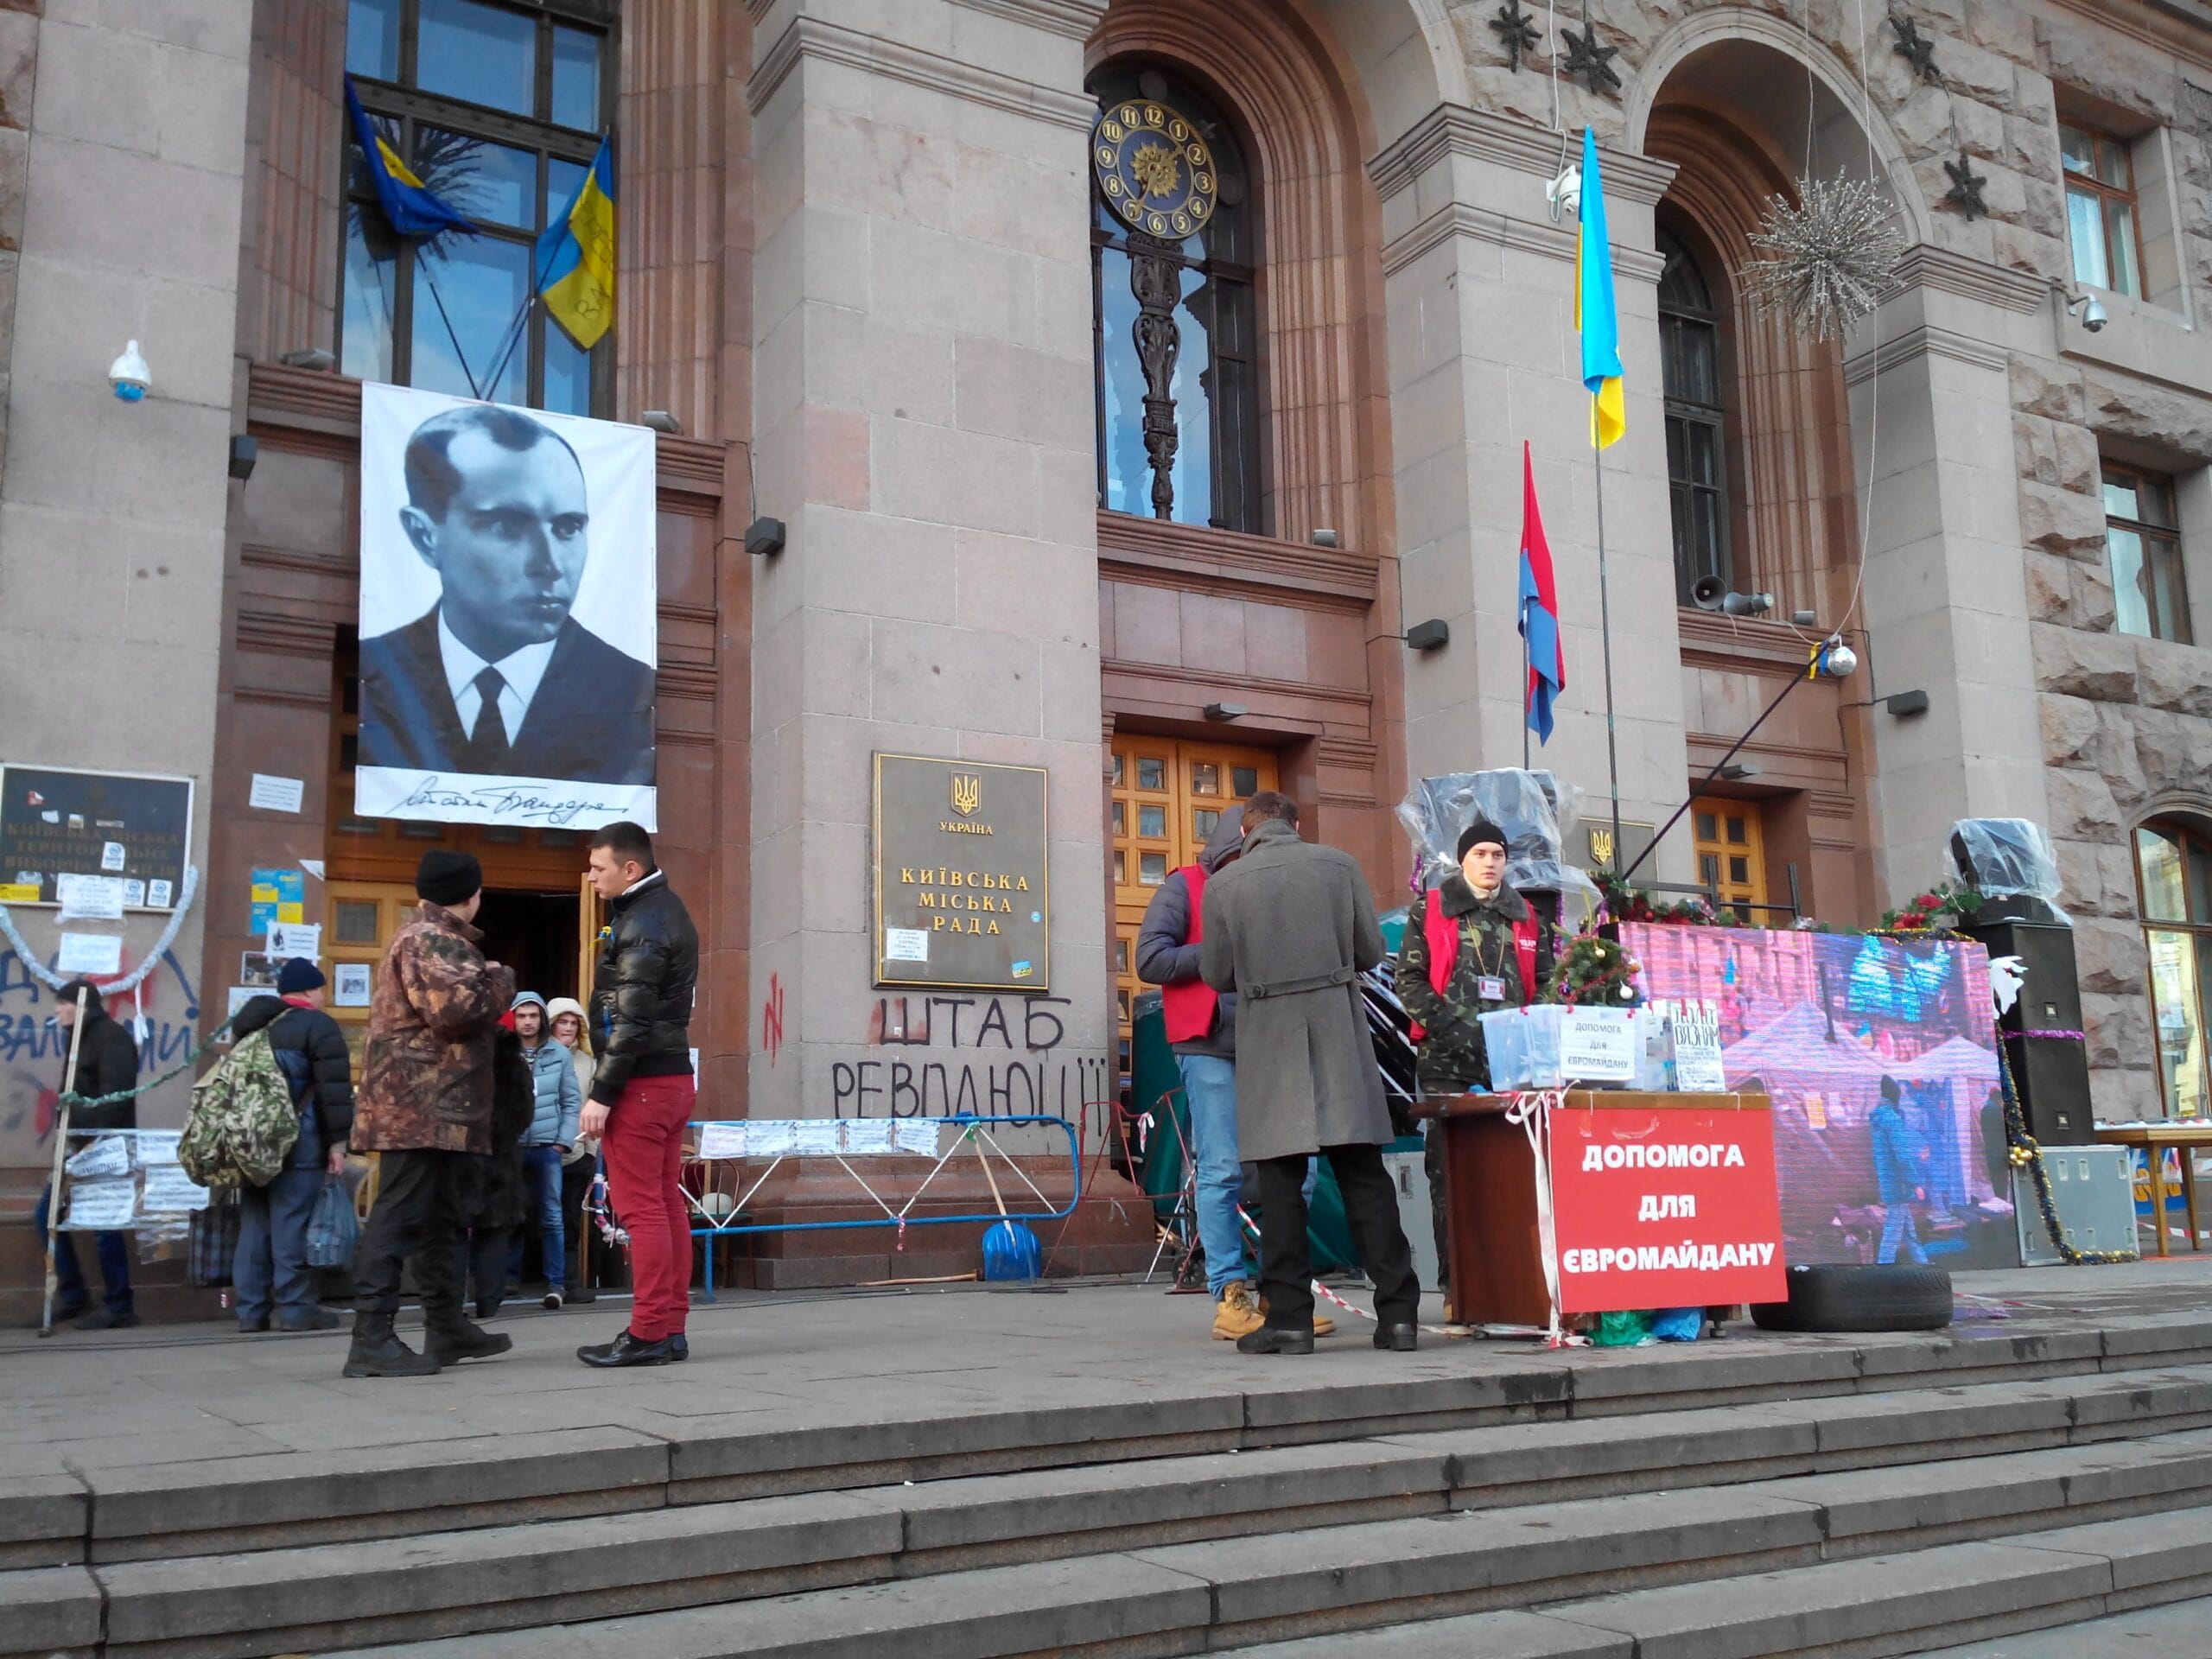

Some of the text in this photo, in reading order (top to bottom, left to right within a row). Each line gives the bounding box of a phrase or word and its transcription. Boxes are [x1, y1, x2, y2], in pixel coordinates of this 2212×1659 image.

[1123, 110, 1136, 124] 11
[1147, 110, 1161, 124] 12
[1105, 124, 1121, 140] 10
[1103, 151, 1111, 164] 9
[1194, 149, 1201, 162] 2
[1109, 179, 1118, 193] 8
[1201, 176, 1209, 189] 3
[1192, 200, 1201, 215] 4
[1153, 218, 1161, 232] 6
[1177, 217, 1185, 230] 5
[939, 821, 994, 836] УКРАЇНА
[900, 867, 1030, 892] КИЇВСЬКА
[918, 892, 1013, 913] МІСЬКА
[933, 916, 1001, 936] РАДА
[879, 996, 1072, 1049] ШТАБ
[1575, 1022, 1622, 1034] ДОПОМОГА
[1590, 1040, 1607, 1051] ДЛЯ
[1567, 1056, 1629, 1069] ЄВРОМАЙДАНУ
[1582, 1144, 1745, 1172] ДОПОМОГА
[1637, 1194, 1696, 1222] ДЛЯ
[1562, 1239, 1775, 1273] ЄВРОМАЙДАНУ
